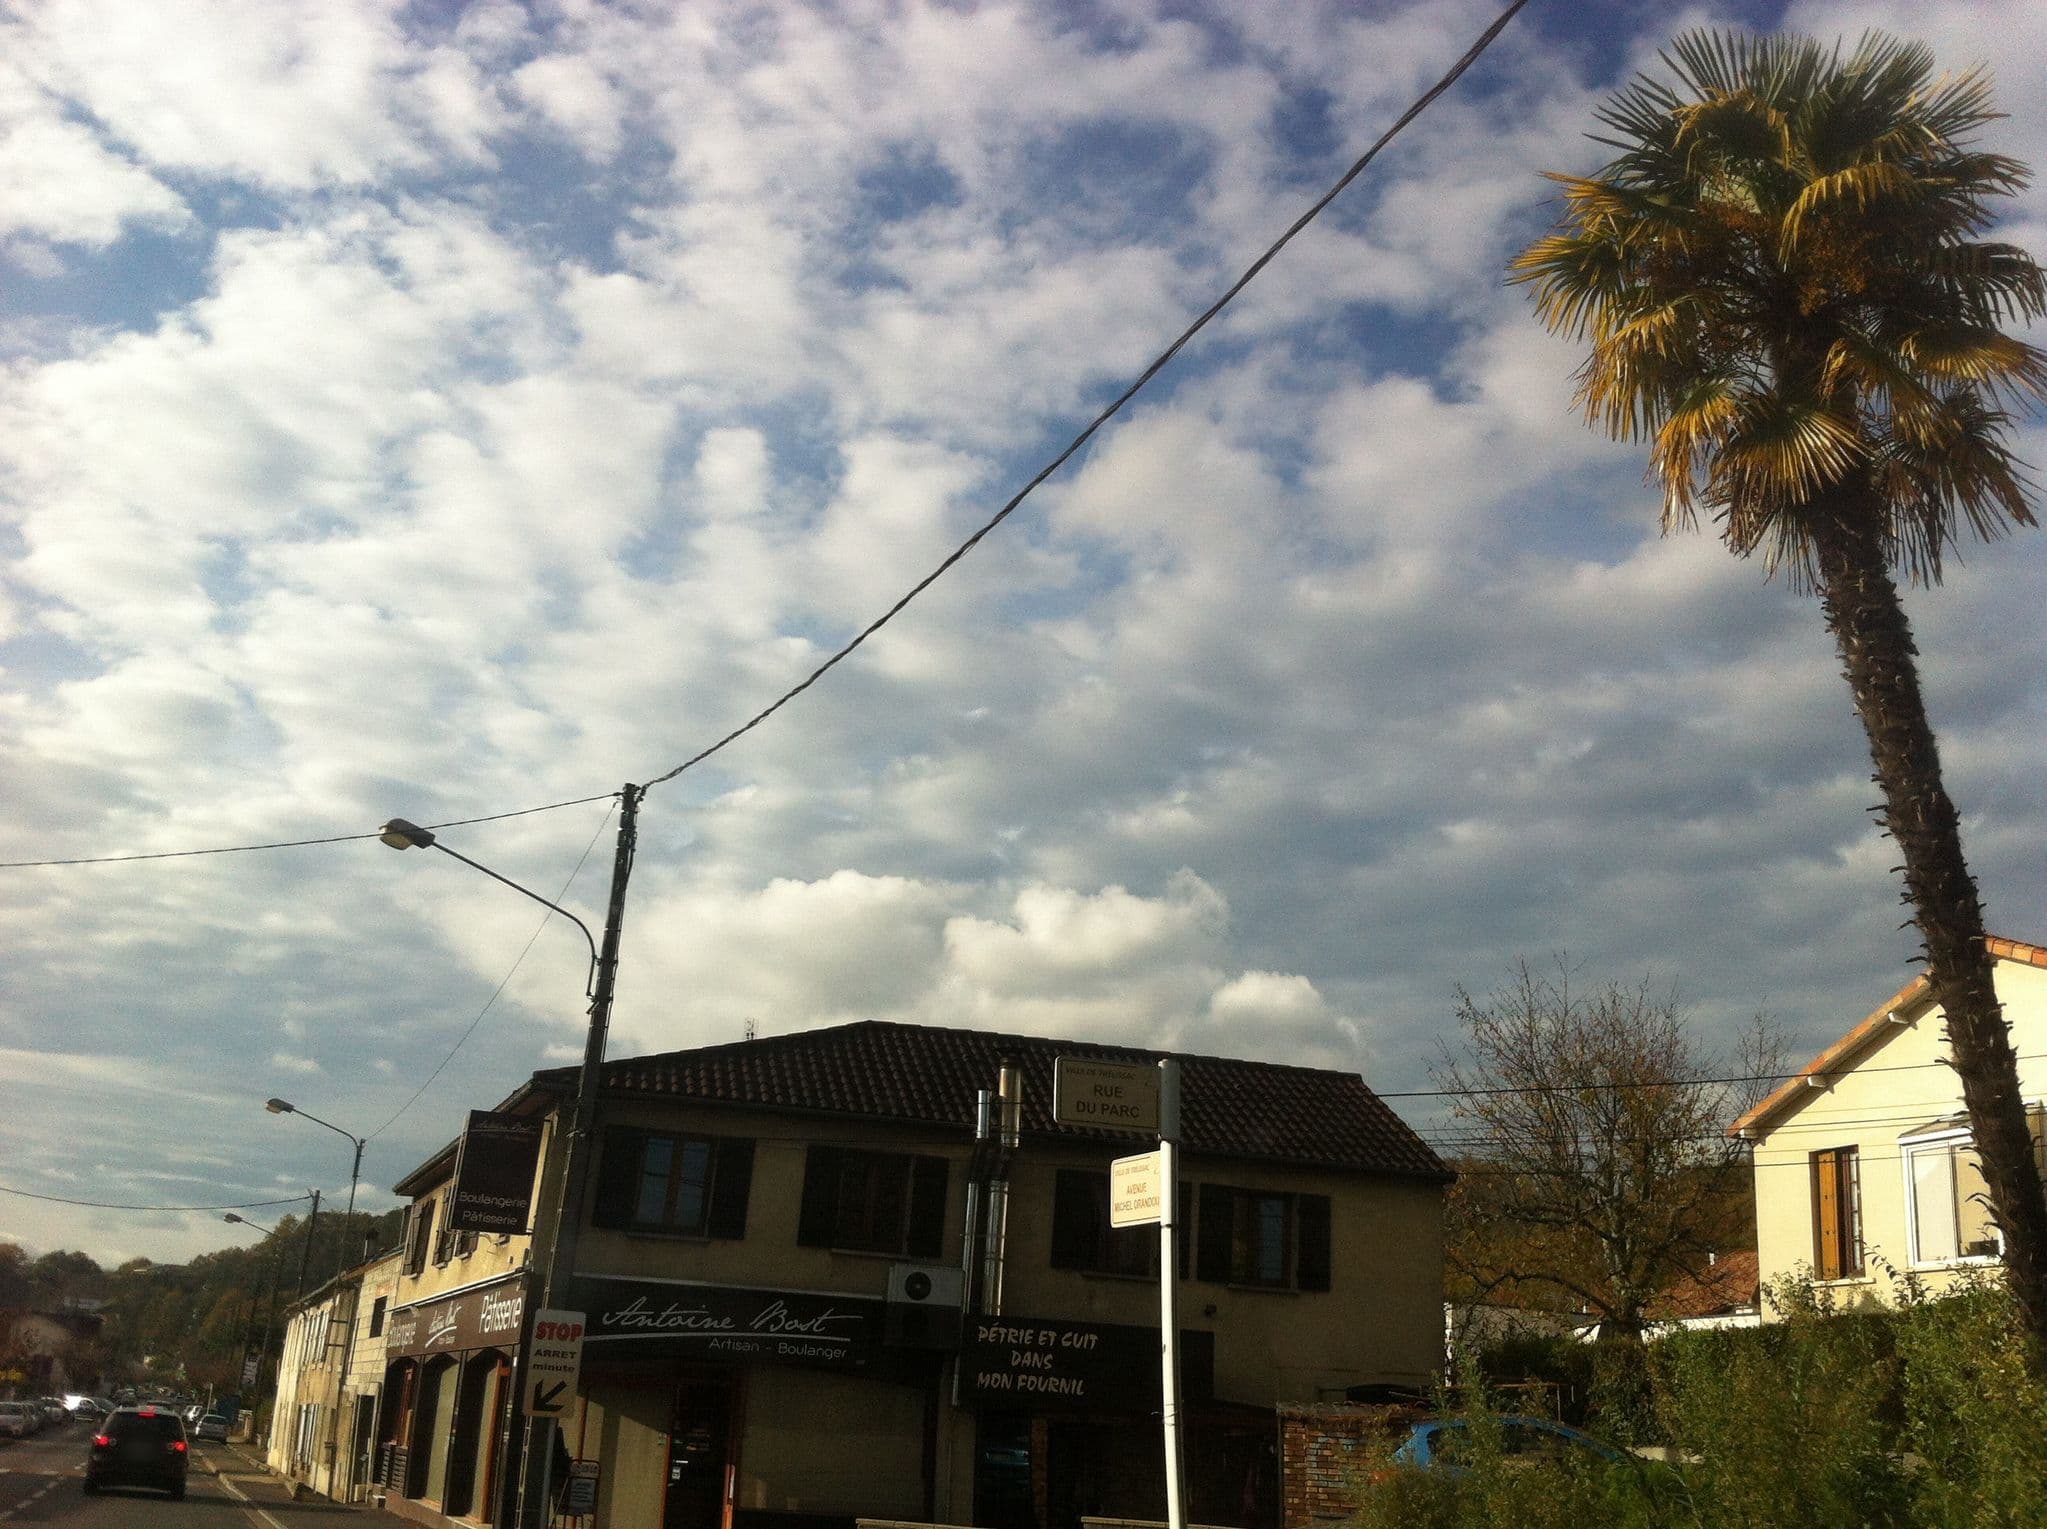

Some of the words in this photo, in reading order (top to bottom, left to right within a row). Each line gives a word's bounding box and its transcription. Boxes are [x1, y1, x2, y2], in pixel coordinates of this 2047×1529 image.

[1094, 1083, 1123, 1098] RUE
[1076, 1100, 1096, 1114] DU
[1101, 1103, 1140, 1118] PARC
[1127, 1183, 1147, 1195] AVENUE
[459, 1192, 528, 1208] Boulangerie
[1114, 1200, 1133, 1212] MICHEL
[462, 1210, 518, 1226] Pâtisserie
[479, 1291, 522, 1334] Pâtisserie
[602, 1296, 735, 1329] Antoine
[750, 1299, 863, 1333] Bost
[535, 1320, 583, 1342] STOP
[977, 1321, 1034, 1345] PÉTRIE
[1038, 1330, 1057, 1347] ET
[1061, 1331, 1099, 1351] CUIT
[709, 1336, 760, 1352] Artisan
[778, 1342, 847, 1360] Boulanger
[532, 1362, 575, 1373] minute
[1011, 1349, 1054, 1370] DANS
[977, 1371, 1013, 1390] MON
[1017, 1374, 1085, 1396] FOURNIL
